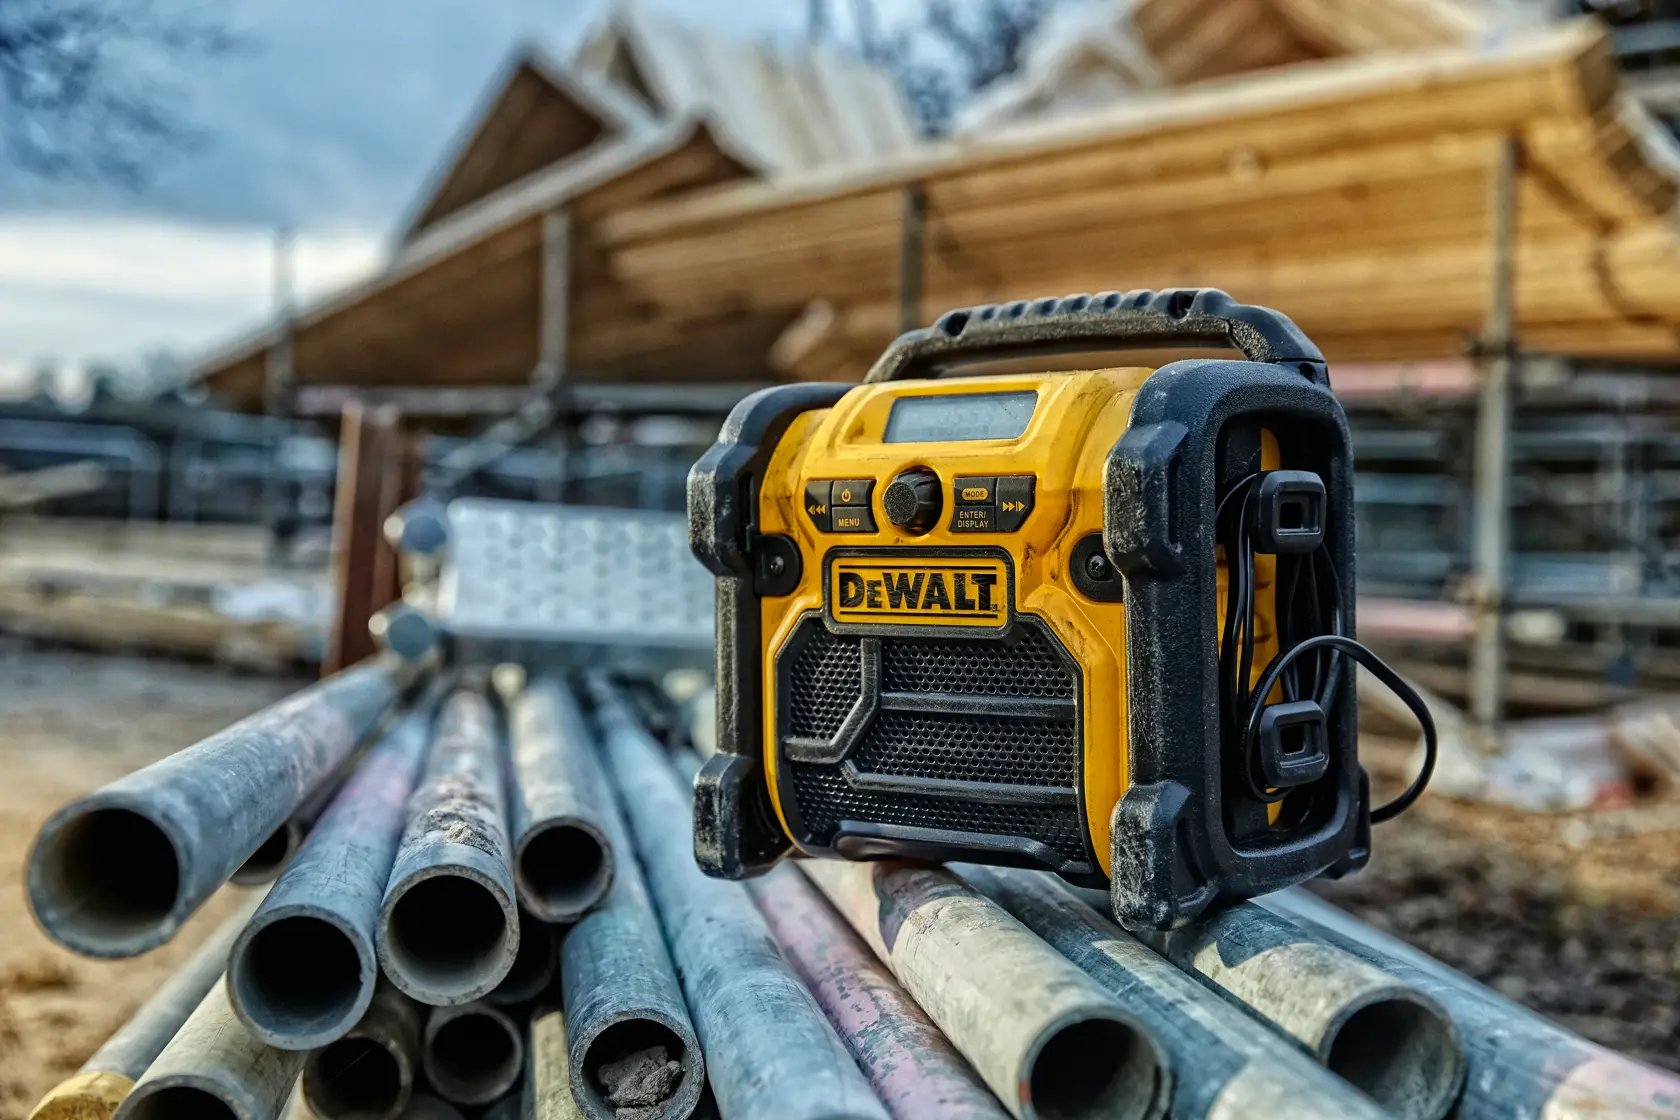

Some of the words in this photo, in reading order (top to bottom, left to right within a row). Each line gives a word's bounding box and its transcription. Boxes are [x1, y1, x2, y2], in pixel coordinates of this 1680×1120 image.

[965, 490, 985, 498] MODE
[959, 511, 986, 519] ENTER/
[838, 518, 860, 527] MENU
[957, 520, 989, 528] DISPLAY
